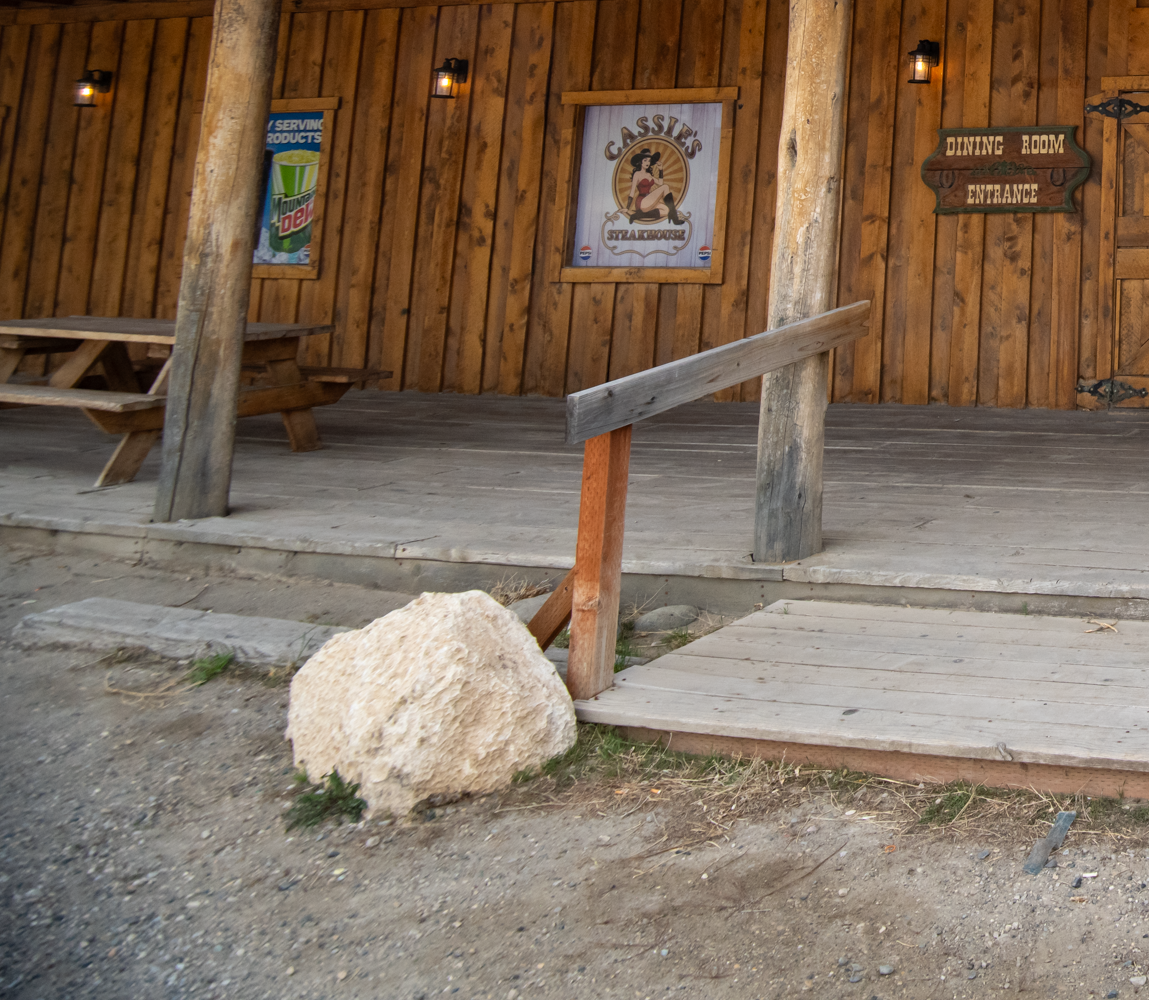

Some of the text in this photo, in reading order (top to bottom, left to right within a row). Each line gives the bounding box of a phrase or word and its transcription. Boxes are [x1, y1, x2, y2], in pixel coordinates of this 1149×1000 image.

[266, 132, 322, 144] RODUCTS
[604, 114, 703, 161] CASSIE'S
[945, 134, 1065, 156] DINING ROOM
[967, 183, 1038, 204] ENTRANCE
[607, 229, 686, 241] STEAKHOUSE
